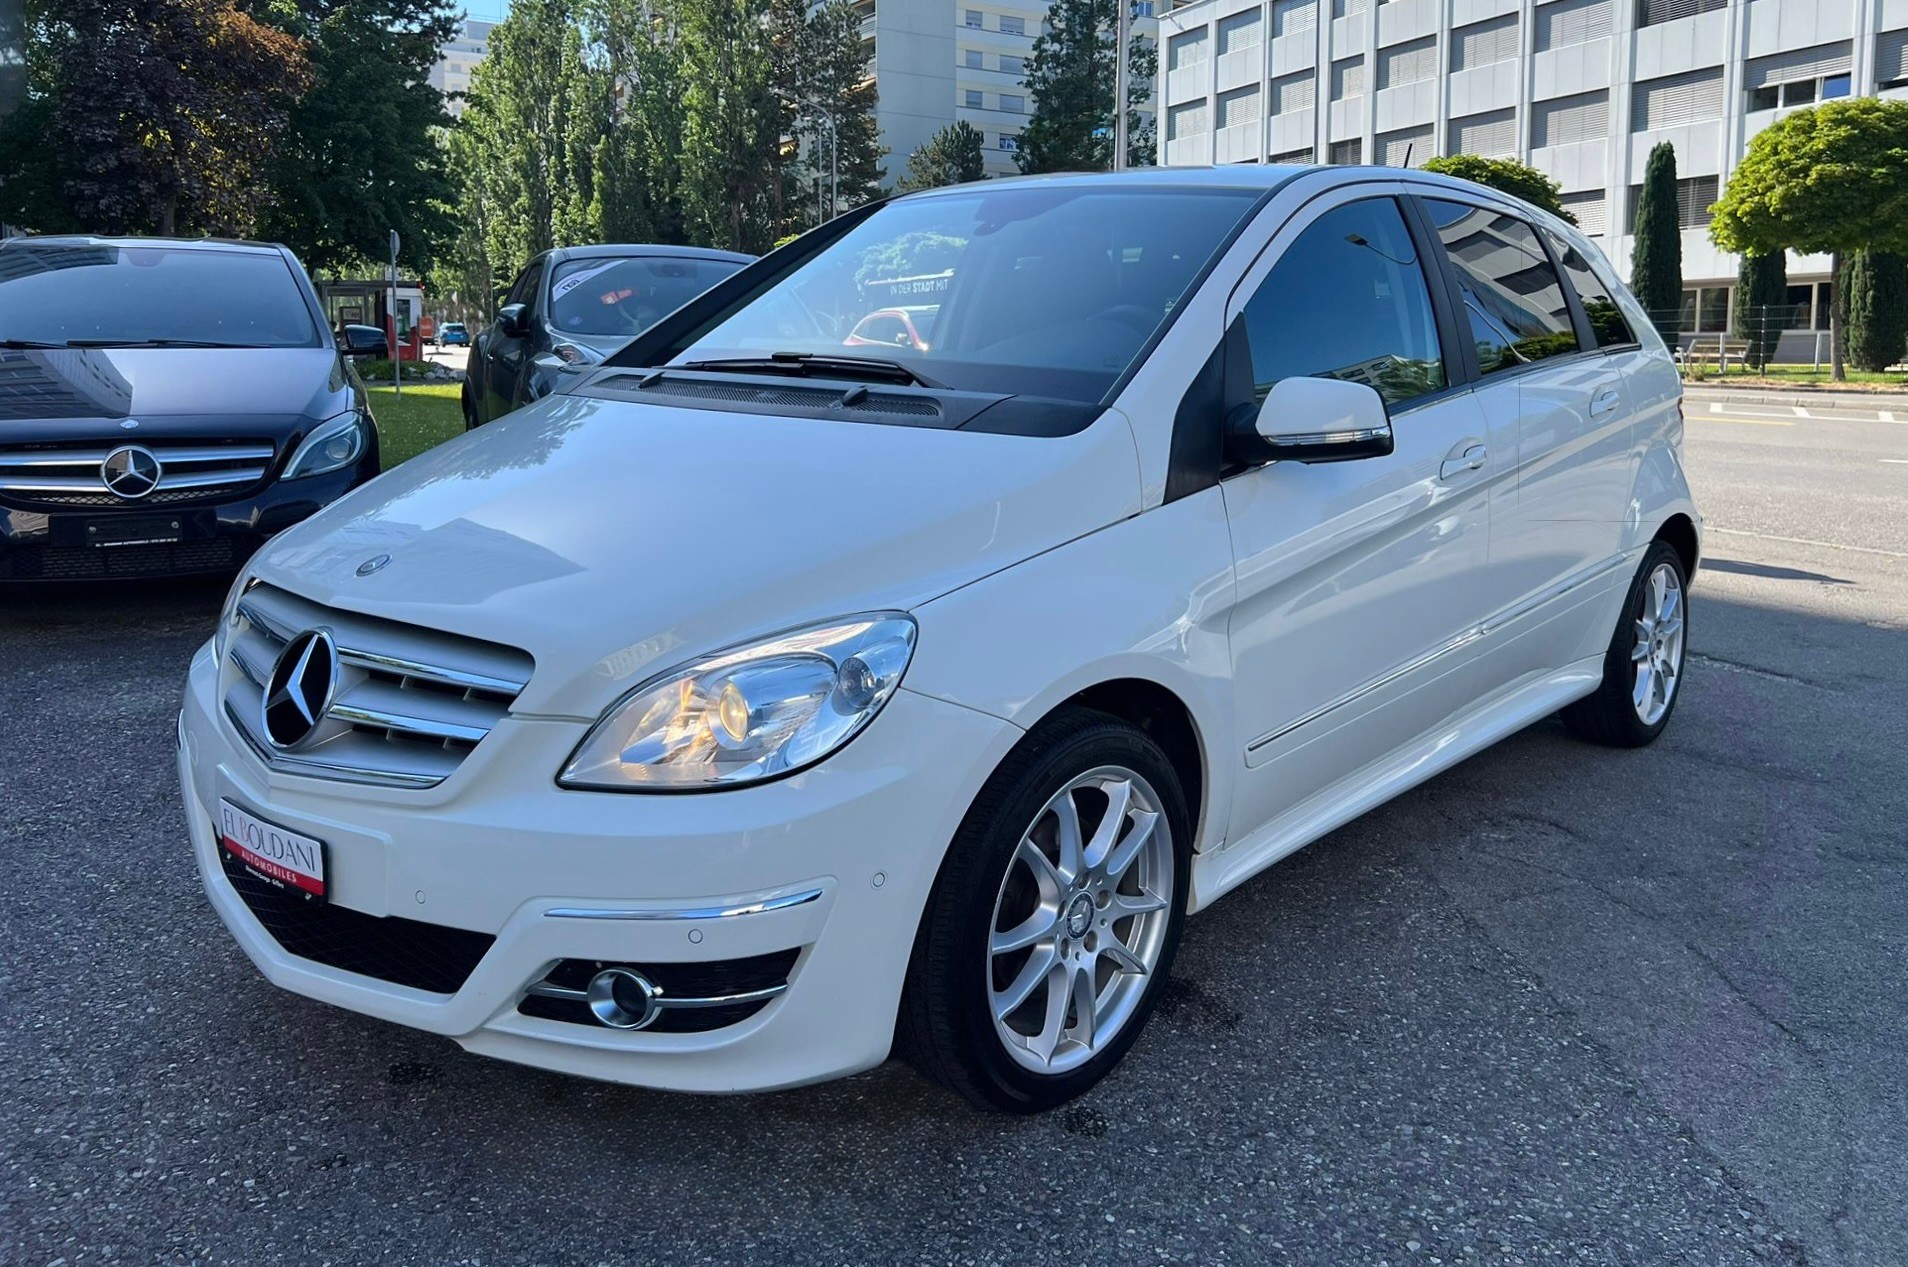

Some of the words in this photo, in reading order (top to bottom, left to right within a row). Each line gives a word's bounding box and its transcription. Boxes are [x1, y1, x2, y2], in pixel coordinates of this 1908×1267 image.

[898, 283, 912, 294] DER
[912, 281, 935, 293] STADT
[935, 279, 949, 291] MIT
[223, 808, 239, 839] EL
[240, 817, 316, 872] BOUDANI
[241, 849, 297, 883] AUTOMOBILES
